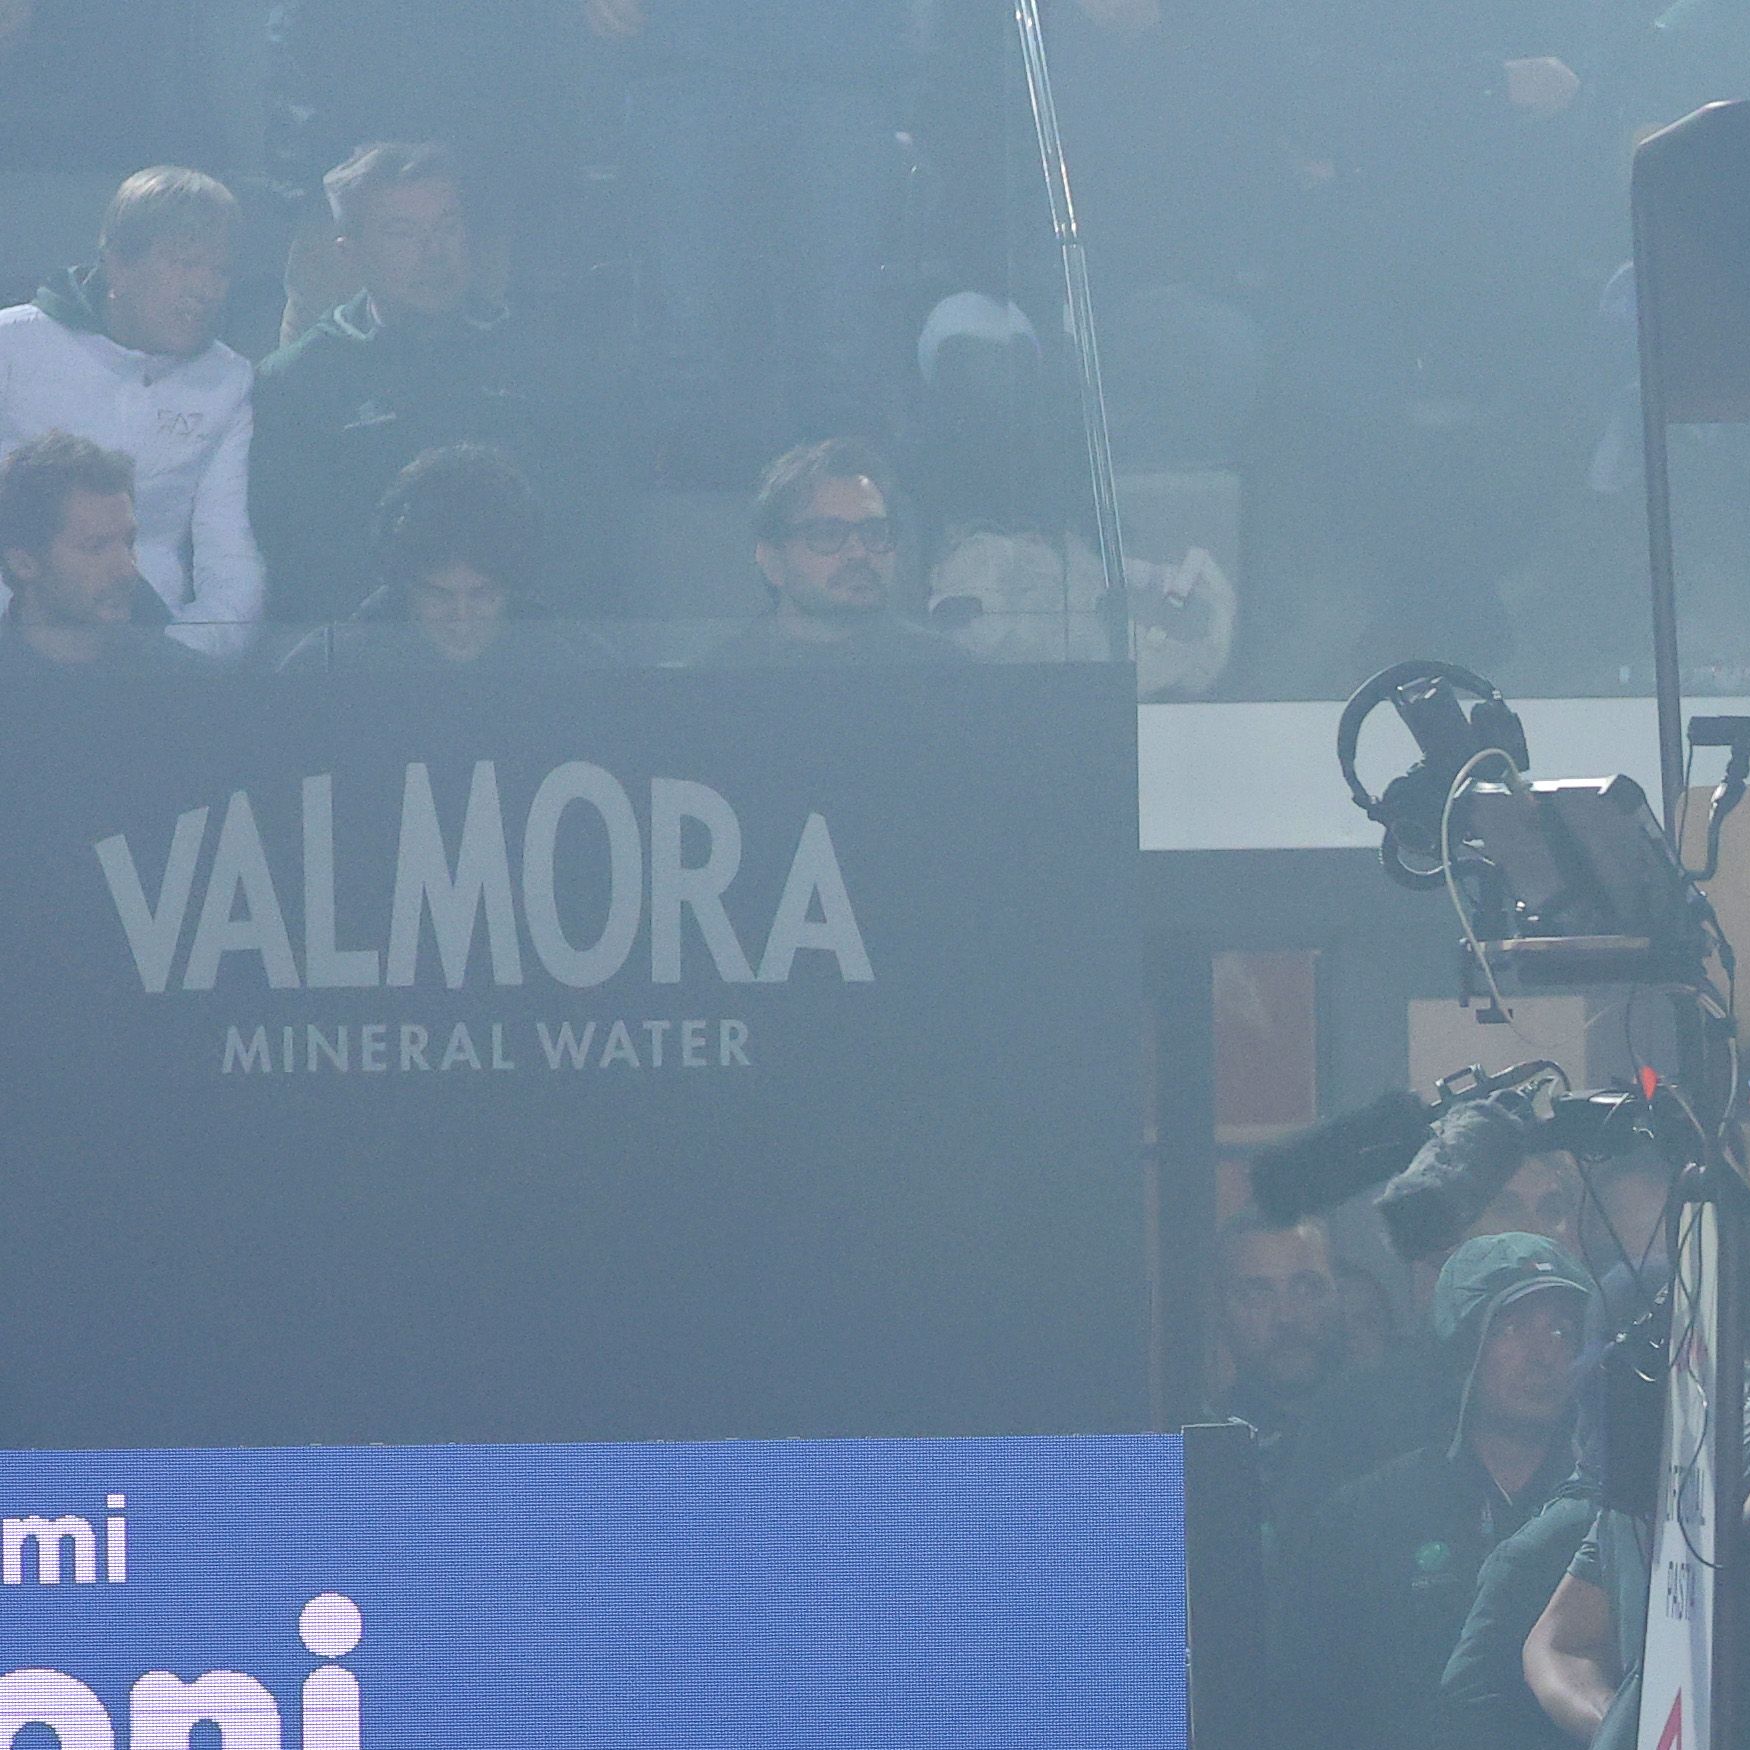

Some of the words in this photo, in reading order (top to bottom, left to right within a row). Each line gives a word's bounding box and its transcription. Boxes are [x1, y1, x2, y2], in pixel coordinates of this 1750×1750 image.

[94, 760, 874, 994] VALMORA
[221, 1022, 516, 1075] MINERAL
[537, 1018, 753, 1070] WATER
